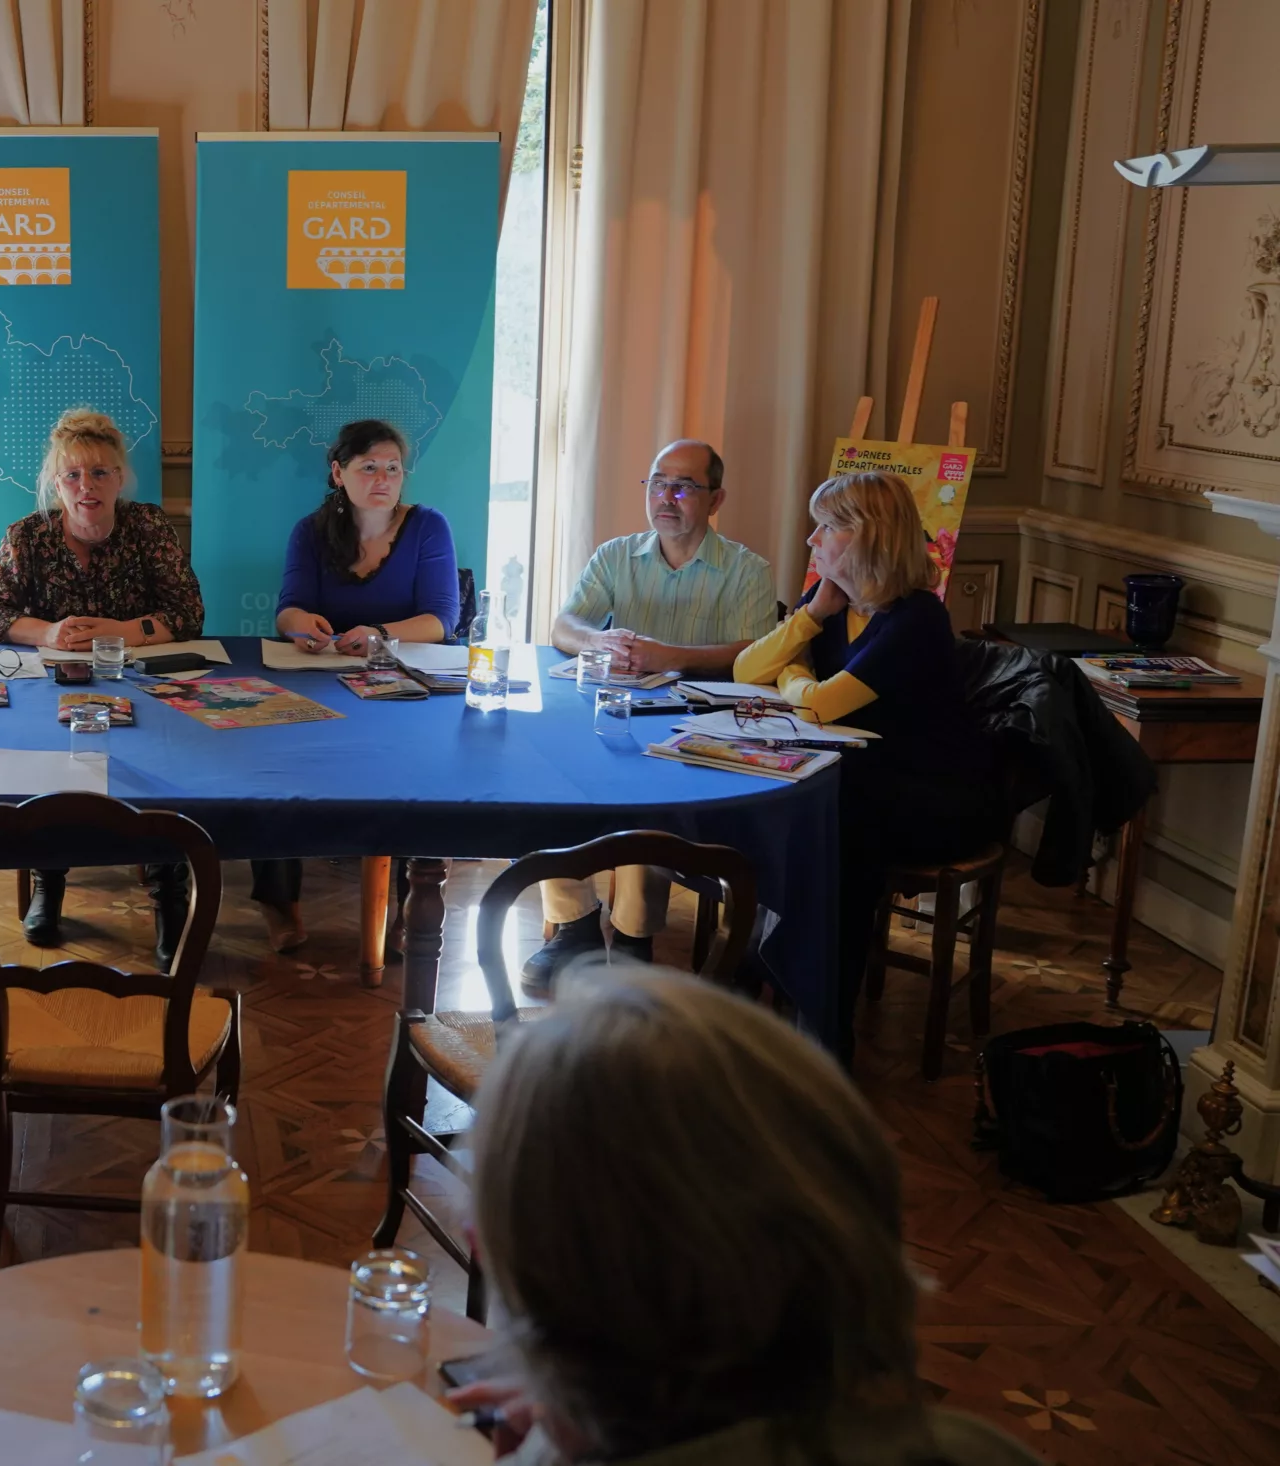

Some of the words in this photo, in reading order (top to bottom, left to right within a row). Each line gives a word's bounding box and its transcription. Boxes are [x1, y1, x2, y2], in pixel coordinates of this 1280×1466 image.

[327, 190, 367, 199] CONSEIL
[308, 200, 387, 209] DÉPARTEMENTAL
[302, 217, 391, 240] GARD
